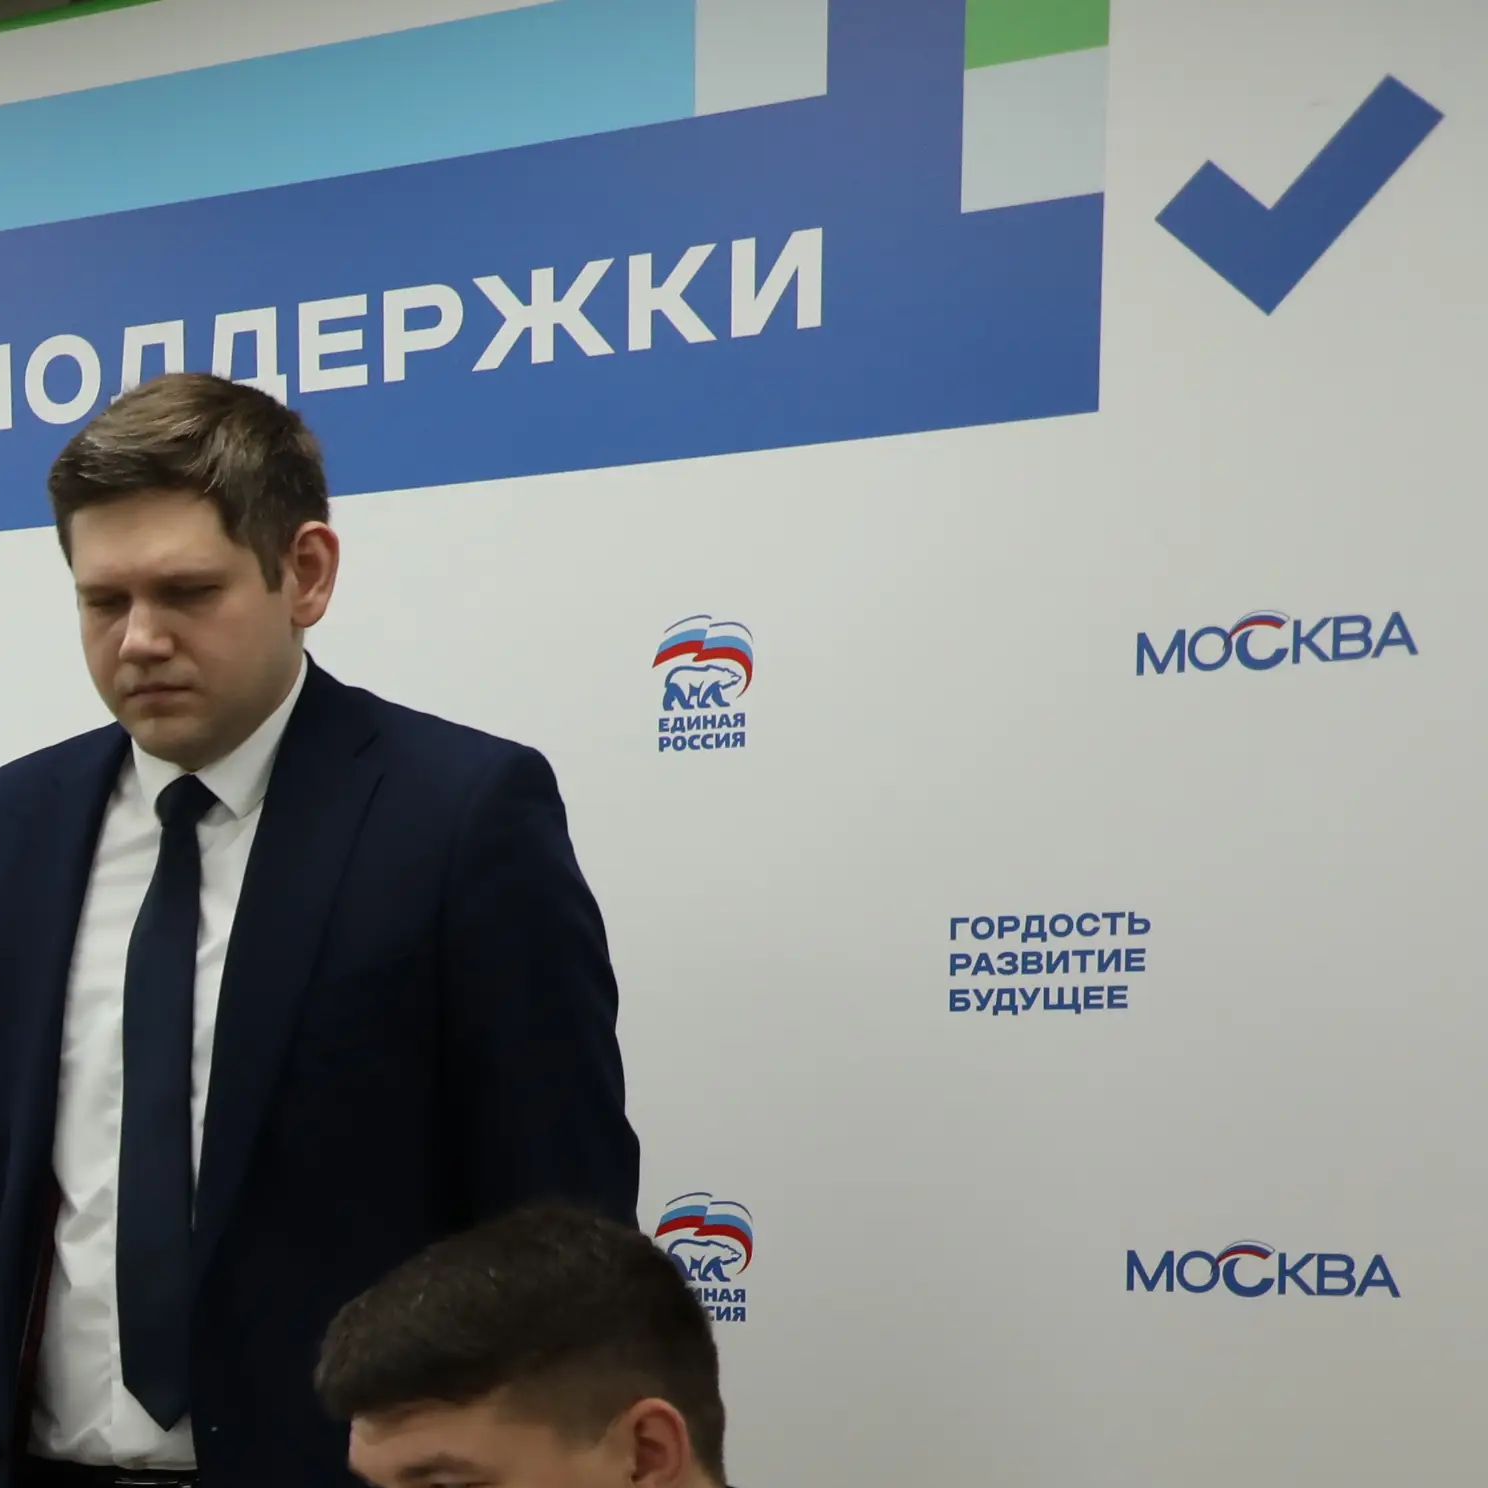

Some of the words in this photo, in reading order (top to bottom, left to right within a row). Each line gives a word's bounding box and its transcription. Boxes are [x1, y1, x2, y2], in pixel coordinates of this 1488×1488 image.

[1136, 610, 1419, 676] МОСКВА
[659, 713, 745, 733] ЕДИНАЯ
[659, 732, 745, 752] РОССИЯ
[950, 912, 1150, 943] ГОРДОСТЬ
[950, 948, 1146, 976] РАЗВИТИЕ
[950, 986, 1128, 1016] БУДУЩЕЕ
[1125, 1240, 1400, 1298] МОСКВА
